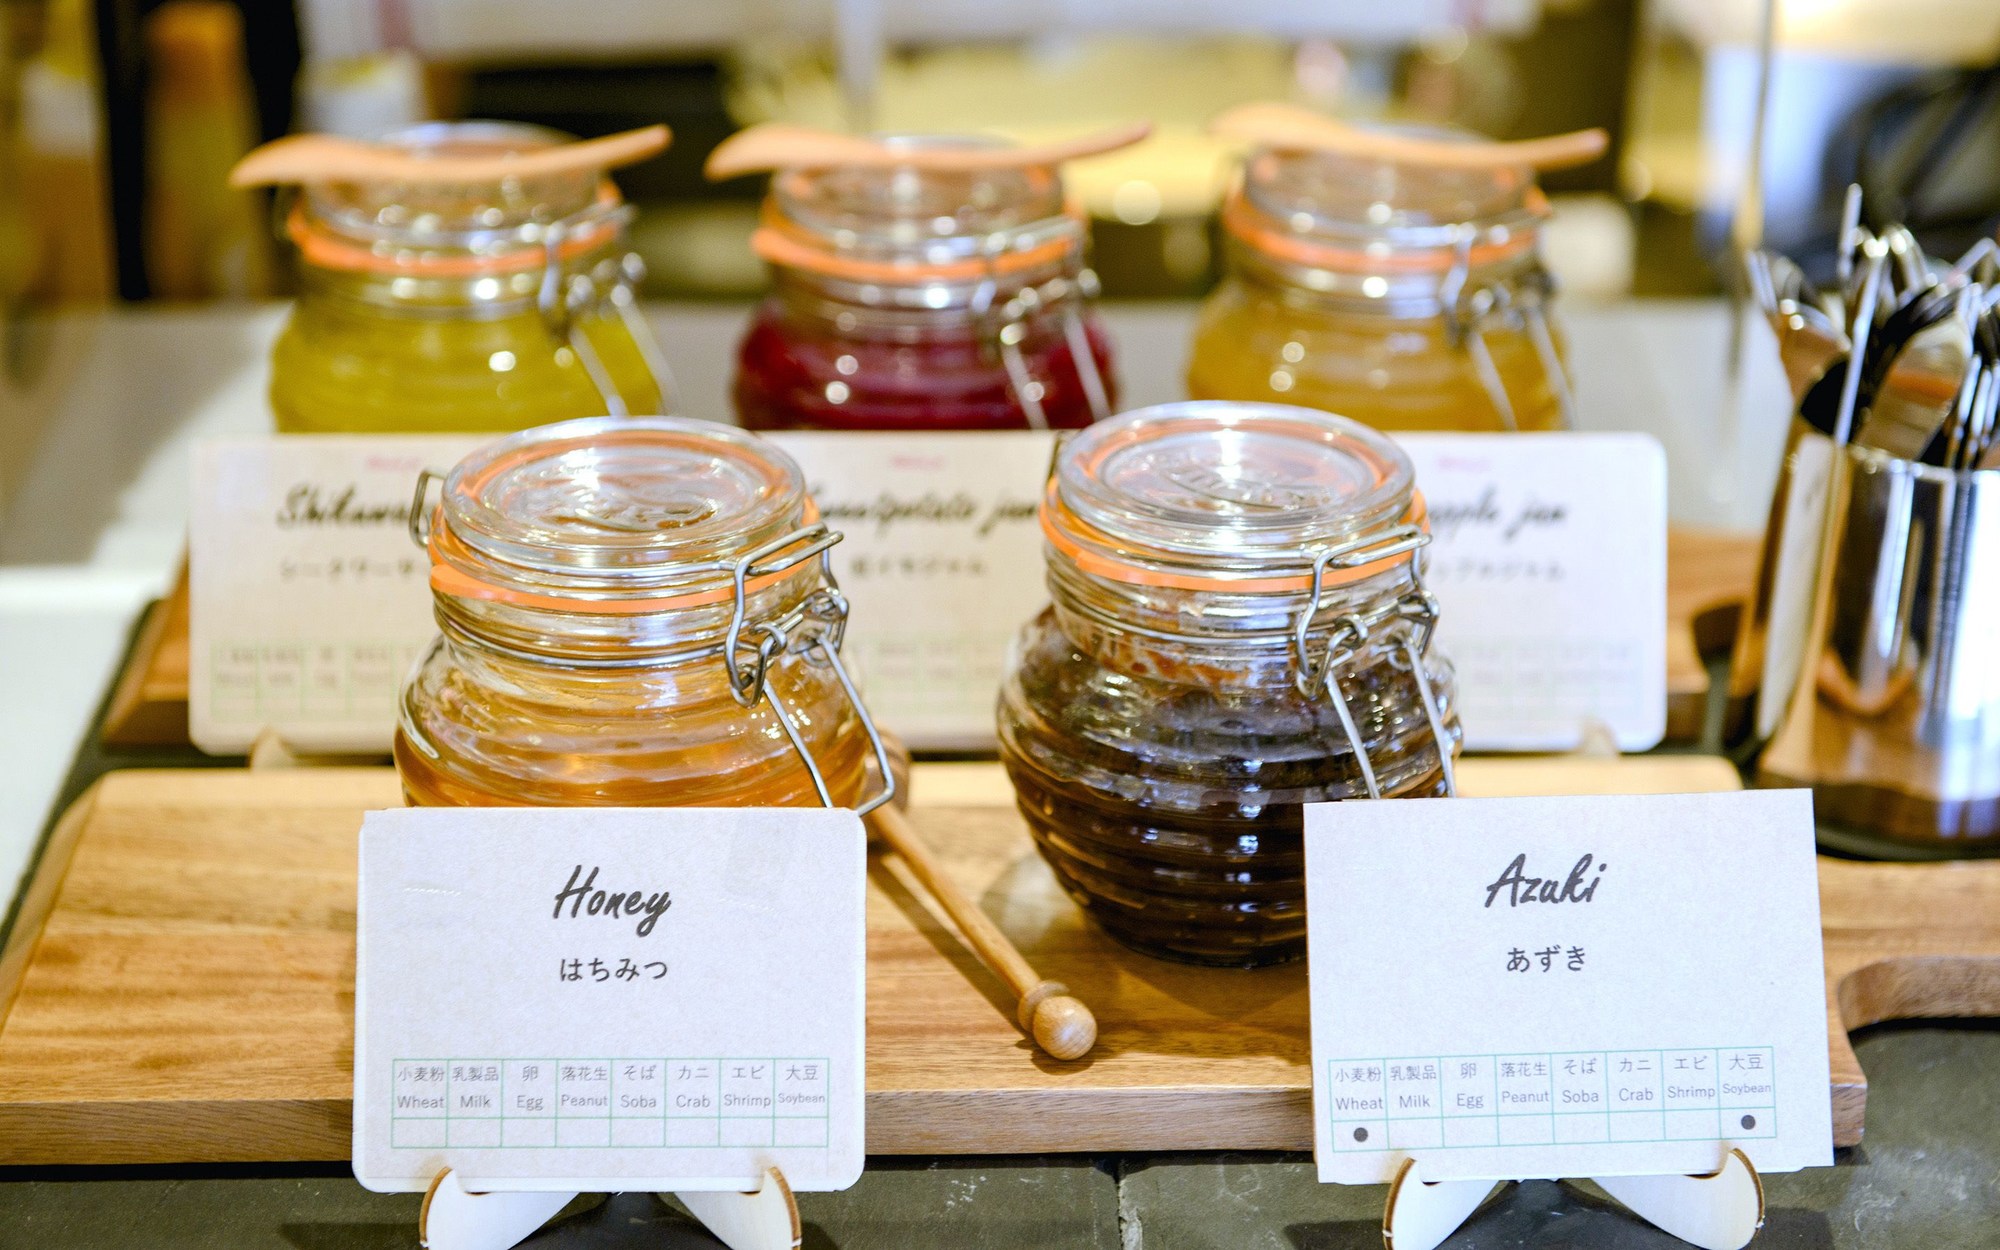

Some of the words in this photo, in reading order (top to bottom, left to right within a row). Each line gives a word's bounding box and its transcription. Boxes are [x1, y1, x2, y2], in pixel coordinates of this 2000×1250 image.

[1483, 852, 1608, 909] Azuki
[551, 864, 673, 939] Honey
[559, 956, 669, 983] はちみつ
[1505, 943, 1586, 974] あずき
[398, 1066, 445, 1082] 小麦粉
[453, 1066, 499, 1082] 乳製品
[522, 1065, 539, 1082] 卵
[562, 1066, 607, 1081] 落花生
[623, 1064, 657, 1081] そば
[678, 1065, 709, 1080] カニ
[733, 1065, 765, 1080] エビ
[785, 1064, 818, 1081] 大豆
[1336, 1067, 1382, 1083] 小麦粉
[1391, 1064, 1437, 1081] 乳製品
[1460, 1062, 1477, 1079] 卵
[1501, 1062, 1547, 1078] 落花生
[1563, 1057, 1597, 1076] そば
[1619, 1057, 1652, 1073] カニ
[1674, 1055, 1708, 1071] エビ
[1729, 1053, 1764, 1071] 大豆
[397, 1095, 445, 1109] Wheat
[460, 1095, 491, 1108] Milk
[516, 1094, 544, 1112] Egg
[561, 1093, 608, 1107] Peanut
[620, 1094, 657, 1109] Soba
[676, 1094, 711, 1108] Crab
[723, 1094, 772, 1108] Shrimp
[777, 1092, 826, 1105] Soybean
[1335, 1097, 1383, 1111] Wheat
[1399, 1094, 1431, 1108] Milk
[1456, 1093, 1484, 1110] Egg
[1502, 1090, 1549, 1103] Peanut
[1562, 1089, 1599, 1104] Soba
[1618, 1087, 1654, 1102] Crab
[1667, 1085, 1716, 1099] Shrimp
[1722, 1083, 1771, 1096] Soybean
